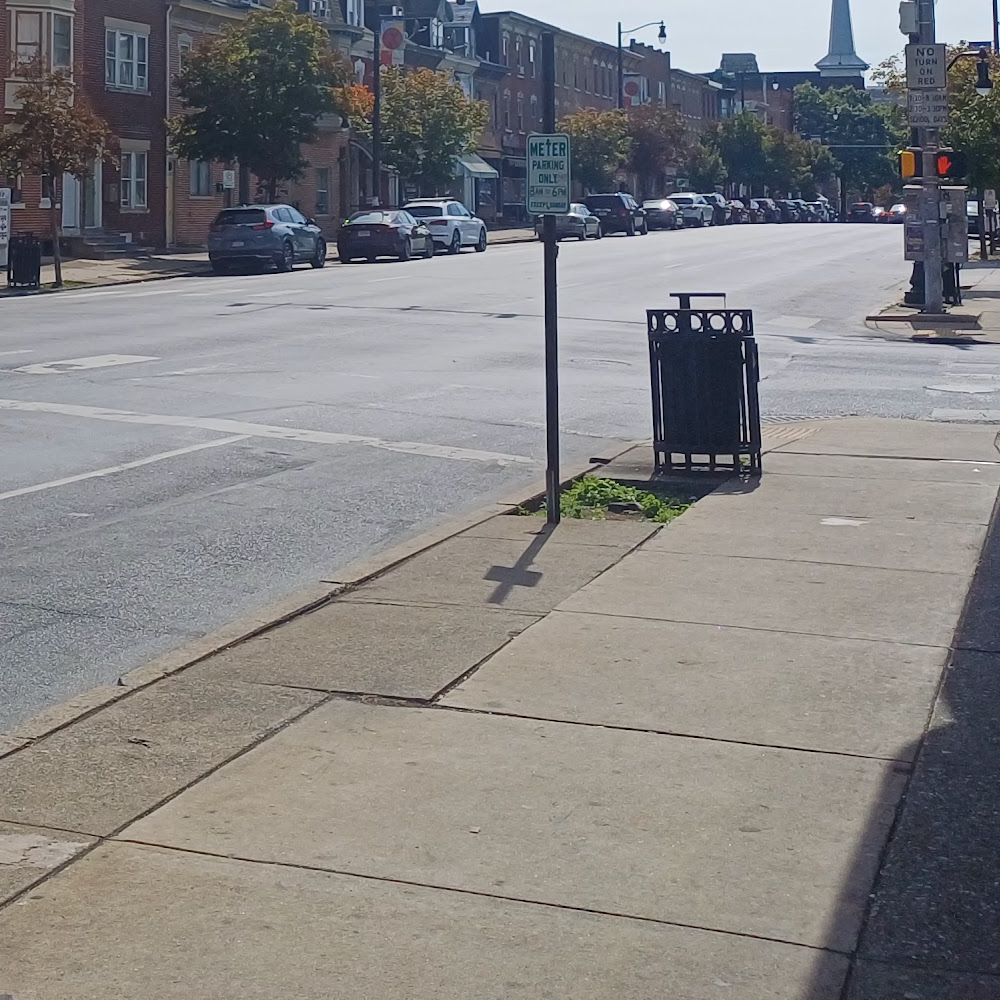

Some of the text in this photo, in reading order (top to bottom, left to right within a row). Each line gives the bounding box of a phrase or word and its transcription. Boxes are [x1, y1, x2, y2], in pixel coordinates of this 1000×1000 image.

[916, 48, 935, 56] NO
[530, 142, 566, 157] METER
[532, 160, 564, 170] PARKING
[539, 173, 558, 184] ONLY
[552, 187, 567, 197] 6PM
